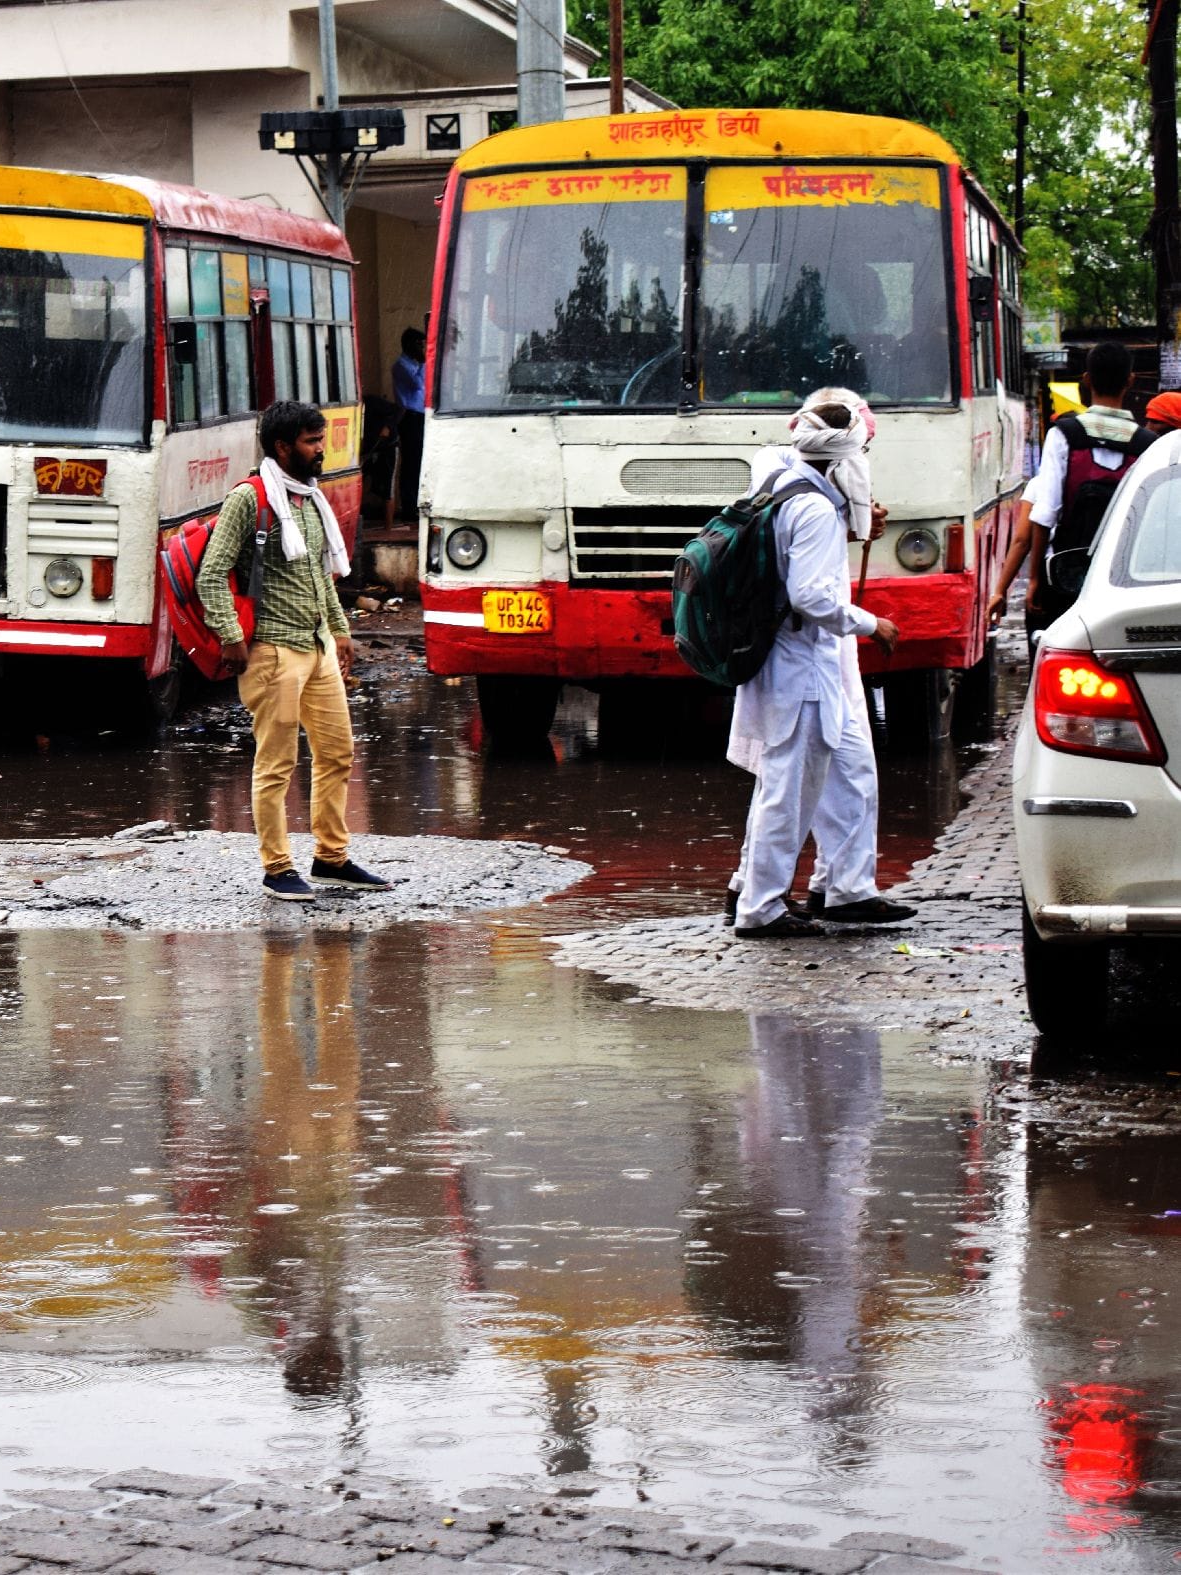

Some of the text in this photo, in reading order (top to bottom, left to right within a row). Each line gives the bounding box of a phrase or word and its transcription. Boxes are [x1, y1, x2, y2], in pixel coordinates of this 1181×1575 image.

[609, 112, 709, 145] शाहजहाँपुर
[497, 597, 543, 612] UP14C
[498, 613, 544, 629] T0344
